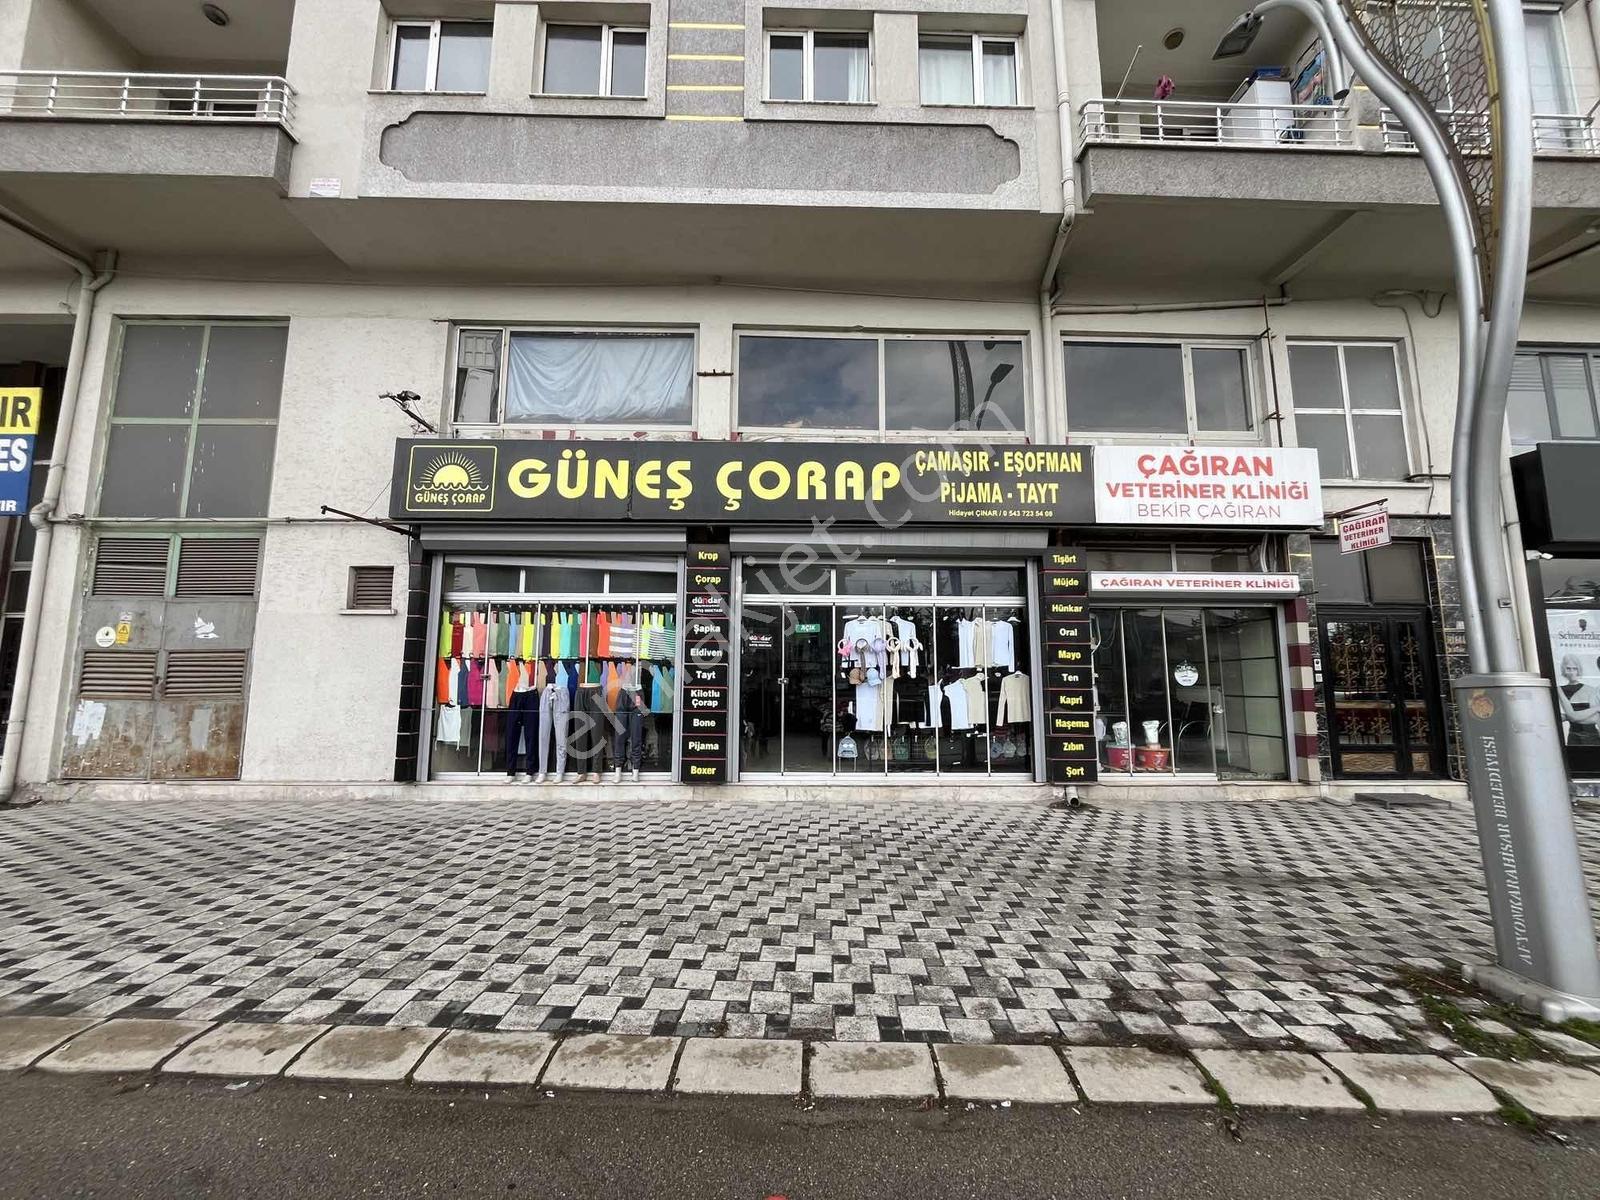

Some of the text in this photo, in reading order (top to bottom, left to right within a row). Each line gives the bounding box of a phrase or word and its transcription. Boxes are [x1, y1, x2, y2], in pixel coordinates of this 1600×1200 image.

[915, 450, 990, 477] ÇAMAŞIR
[1003, 451, 1082, 477] EŞOFMAN
[1137, 450, 1273, 479] ÇAĞIRAN
[507, 449, 901, 510] GÜNEŞ ÇORAP
[1017, 483, 1059, 504] TAYT
[1106, 480, 1309, 500] VETERİNER KLİNİĞİ
[415, 491, 486, 505] GÜNEŞ ÇORAP
[1138, 502, 1281, 520] BEKİR ÇAĞIRAN
[698, 551, 719, 561] Krop
[1052, 555, 1077, 565] Tişört
[695, 575, 721, 584] Çorap
[1053, 578, 1079, 588] Müjde
[1100, 577, 1294, 589] ÇAĞIRAN VETERİNER KLİNİĞİ
[1051, 604, 1083, 613] Hünkar
[693, 624, 721, 634] Şapka
[1059, 628, 1078, 637] Oral
[690, 648, 723, 657] Eldiven
[1058, 650, 1081, 660] Mayo
[696, 671, 716, 680] Tayt
[1061, 673, 1079, 682] Ten
[690, 690, 720, 698] Kilotlu
[691, 699, 718, 708] Çorap
[1060, 695, 1083, 705] Kapri
[693, 719, 716, 727] Bone
[1055, 719, 1089, 730] Haşema
[688, 742, 719, 751] Pijama
[690, 766, 716, 775] Boxer
[1065, 766, 1084, 777] Şort
